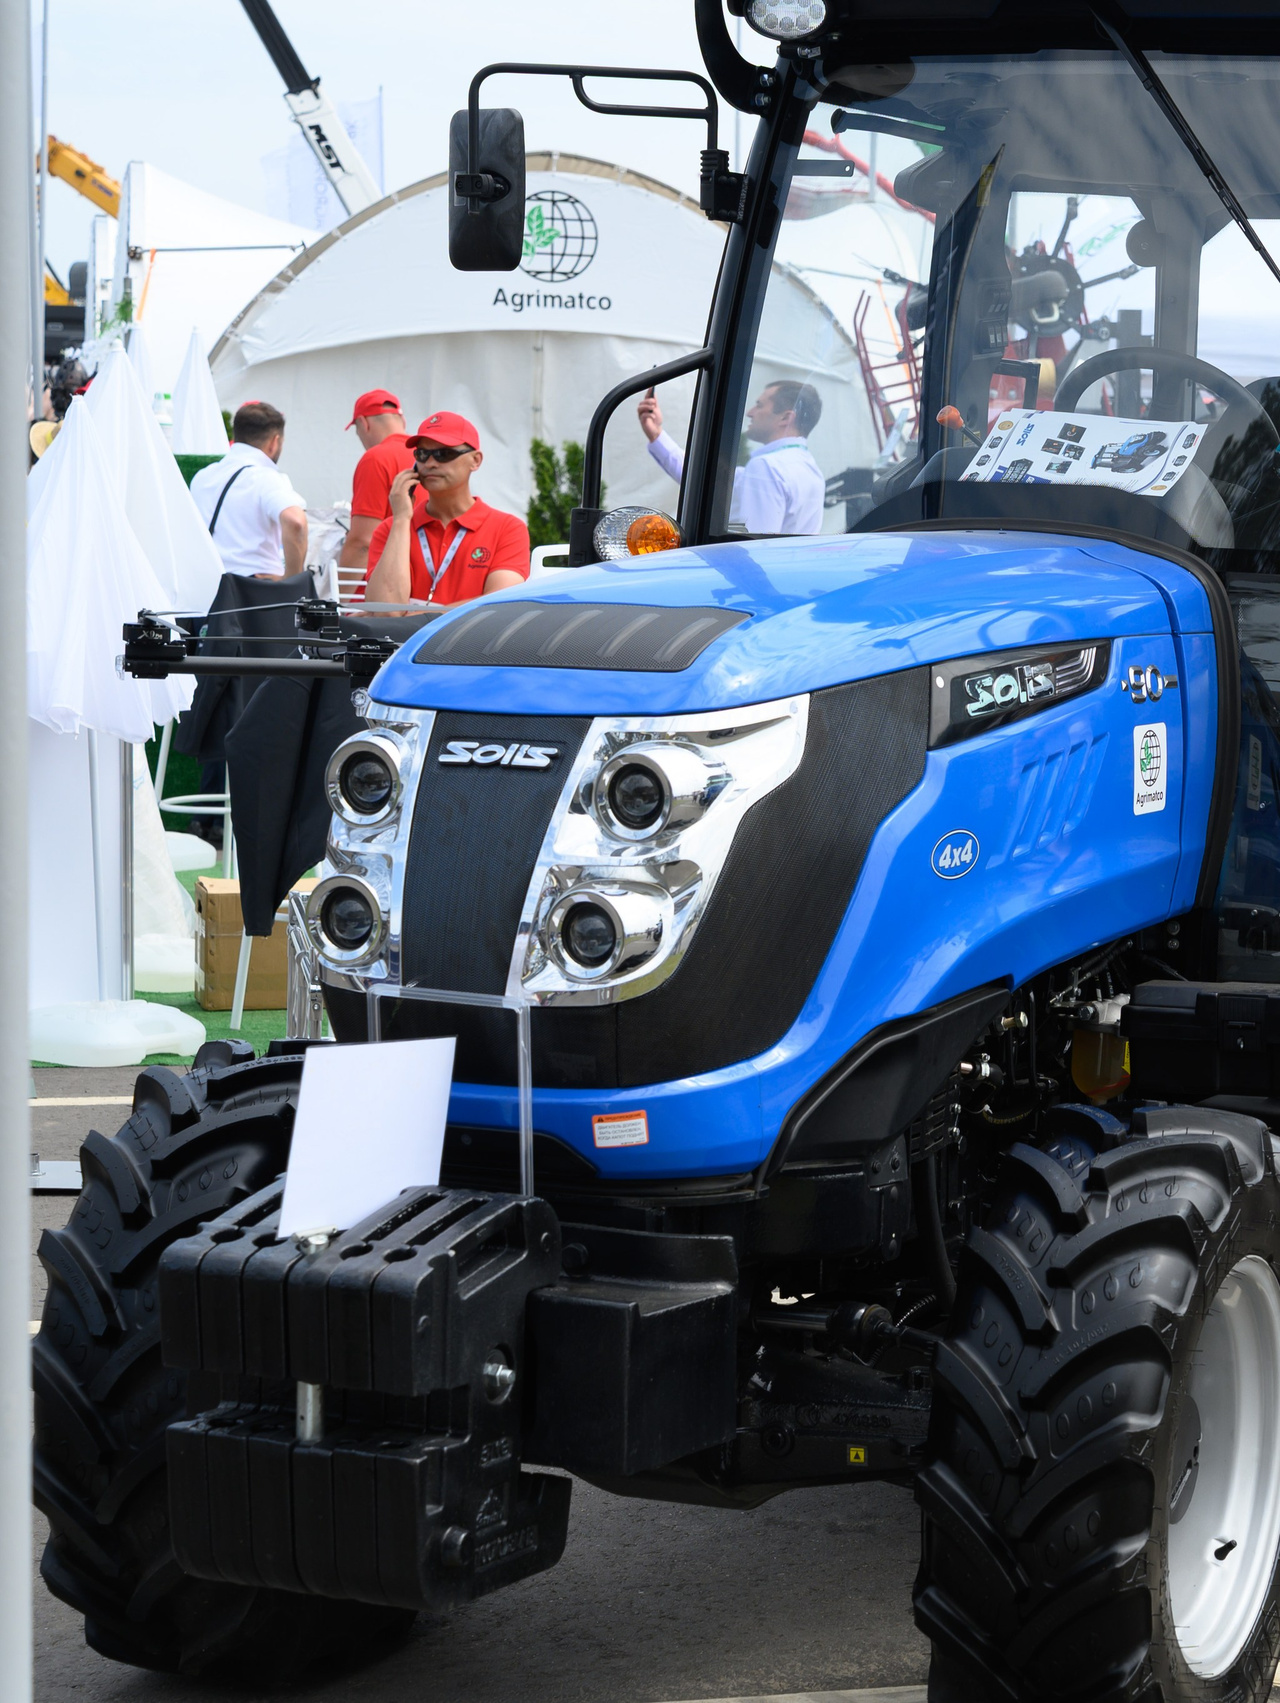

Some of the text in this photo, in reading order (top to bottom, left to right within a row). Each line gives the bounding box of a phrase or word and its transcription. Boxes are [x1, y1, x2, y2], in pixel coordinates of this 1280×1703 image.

[308, 124, 346, 173] MST
[493, 287, 612, 312] Agrimatco
[1135, 790, 1164, 808] Agrimatco
[939, 838, 973, 869] 4x4
